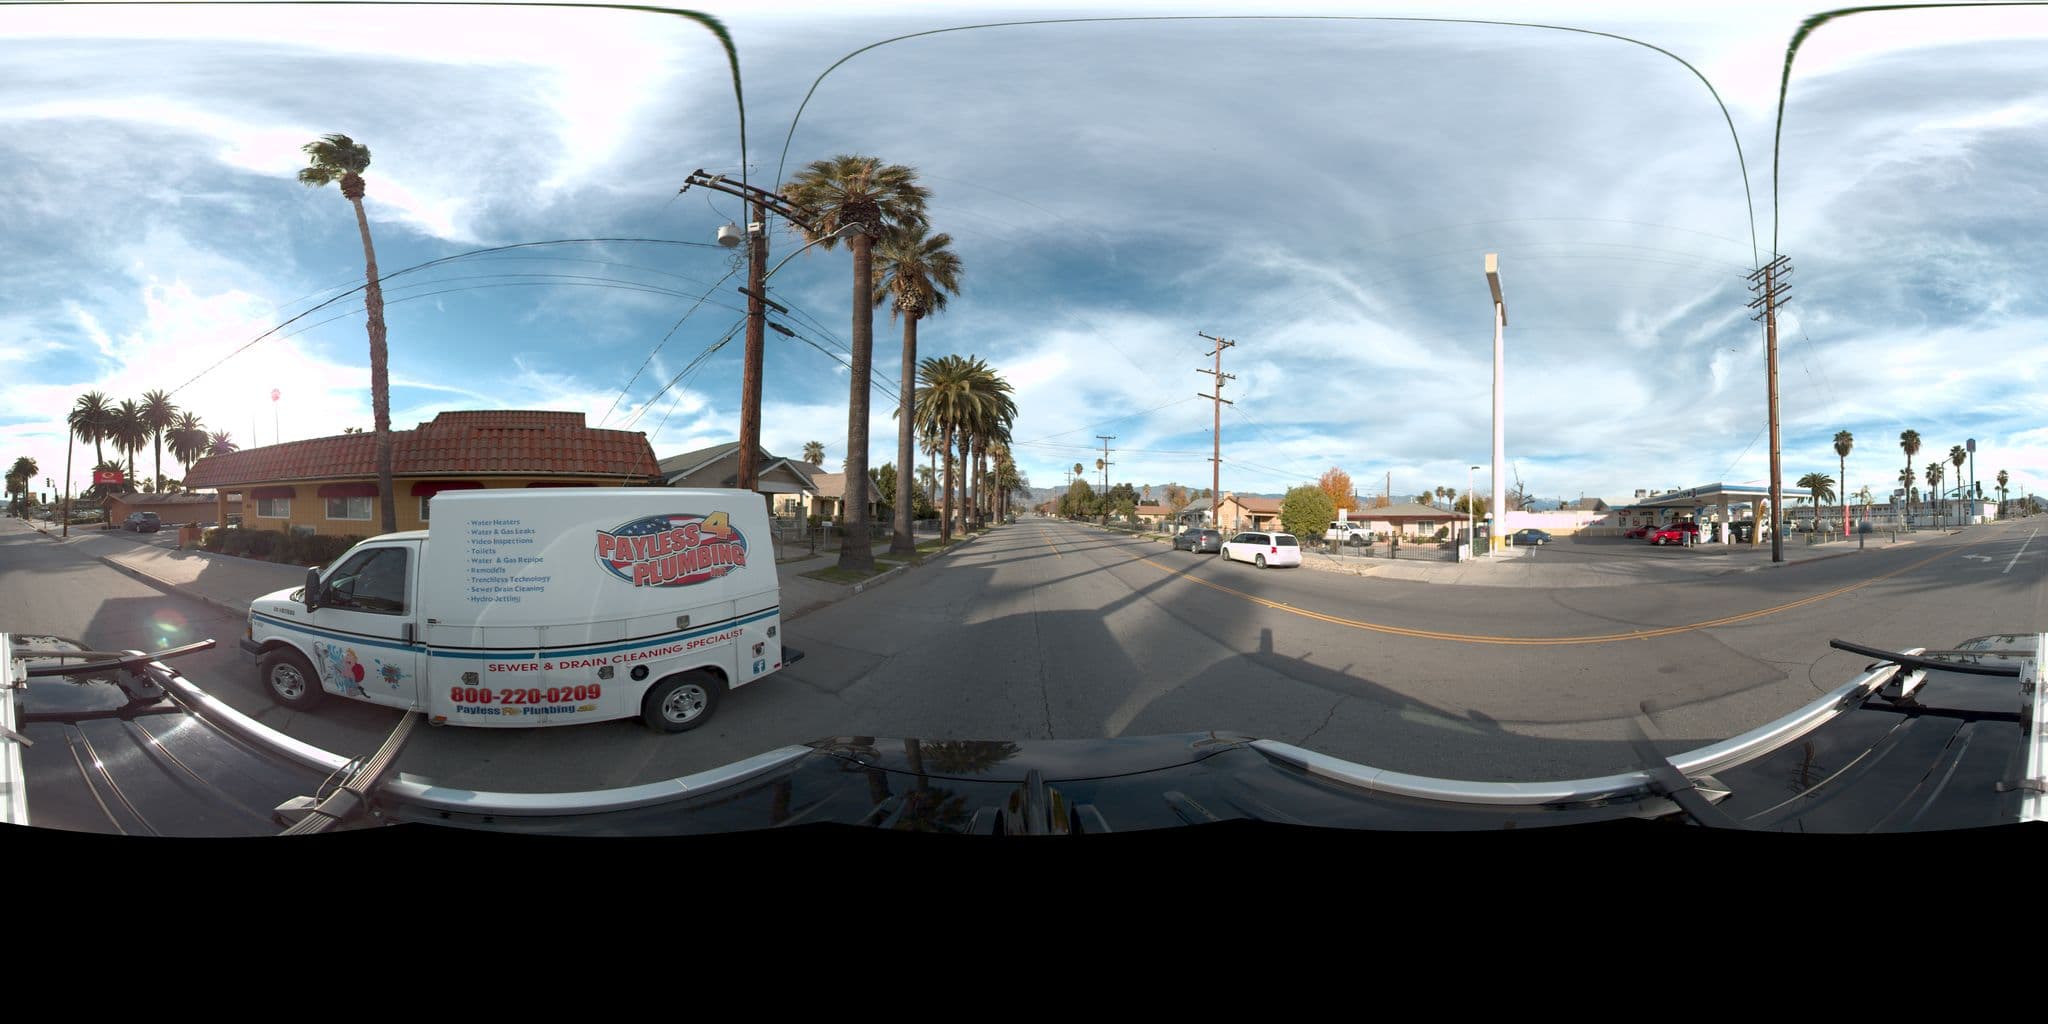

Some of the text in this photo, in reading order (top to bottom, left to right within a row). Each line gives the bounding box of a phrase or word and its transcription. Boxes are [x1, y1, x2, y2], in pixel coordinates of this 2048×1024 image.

[471, 528, 493, 536] Water
[595, 511, 733, 561] PAYLESS 4
[493, 537, 534, 546] Inspections
[633, 544, 746, 587] PLUMBING
[471, 575, 552, 584] Trenchless Technology
[514, 584, 545, 592] Cleaning
[488, 628, 744, 673] SEWER & DRAIN CLEANING SPECIALIST
[450, 683, 602, 705] 800-220-0209
[456, 704, 500, 716] Payless
